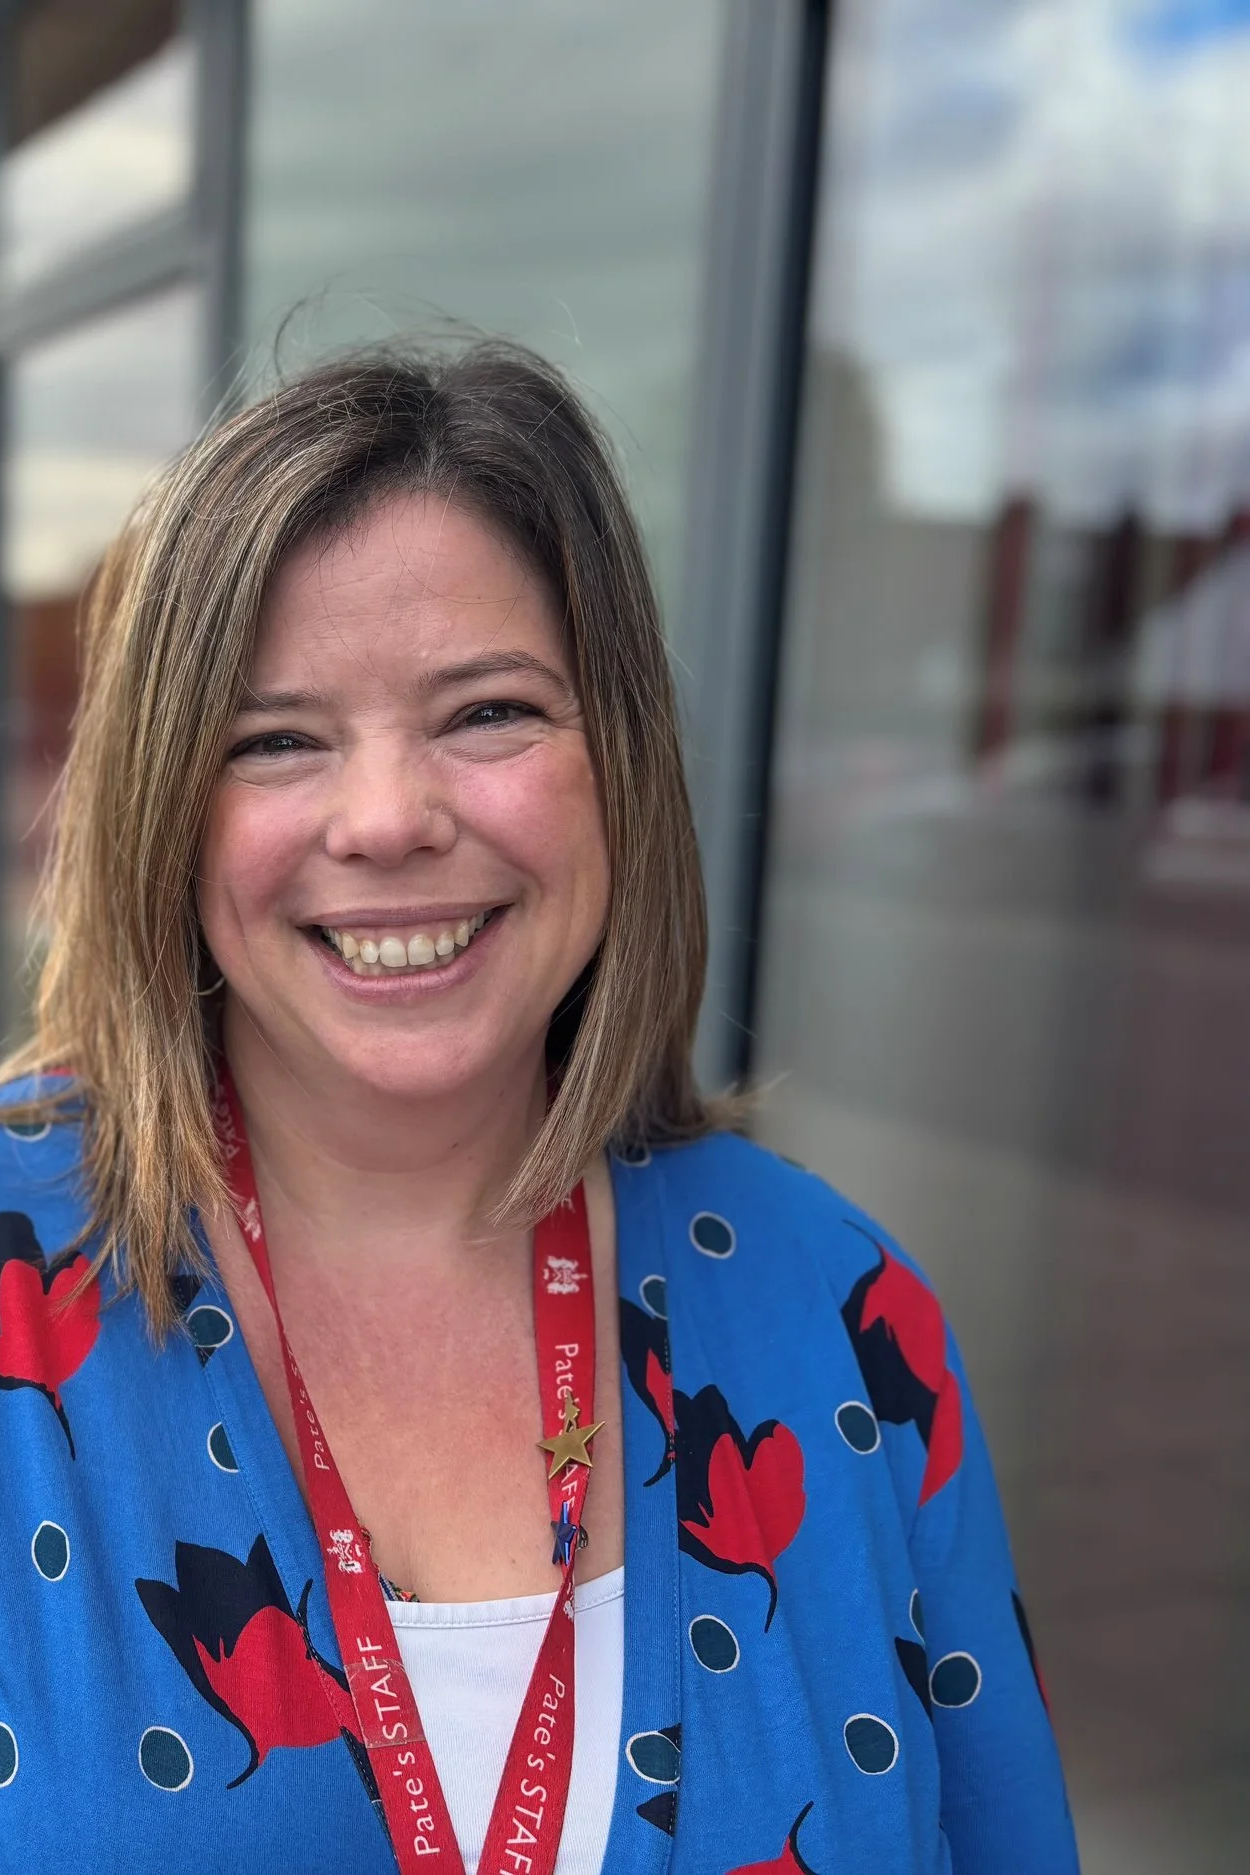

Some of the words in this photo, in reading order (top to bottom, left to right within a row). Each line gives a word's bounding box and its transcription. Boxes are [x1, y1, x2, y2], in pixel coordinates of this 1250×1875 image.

[299, 1389, 330, 1471] Pate's
[356, 1636, 408, 1740] STAFF
[527, 1673, 565, 1771] Pate's
[393, 1751, 440, 1855] Pate's
[499, 1778, 547, 1875] STAF
